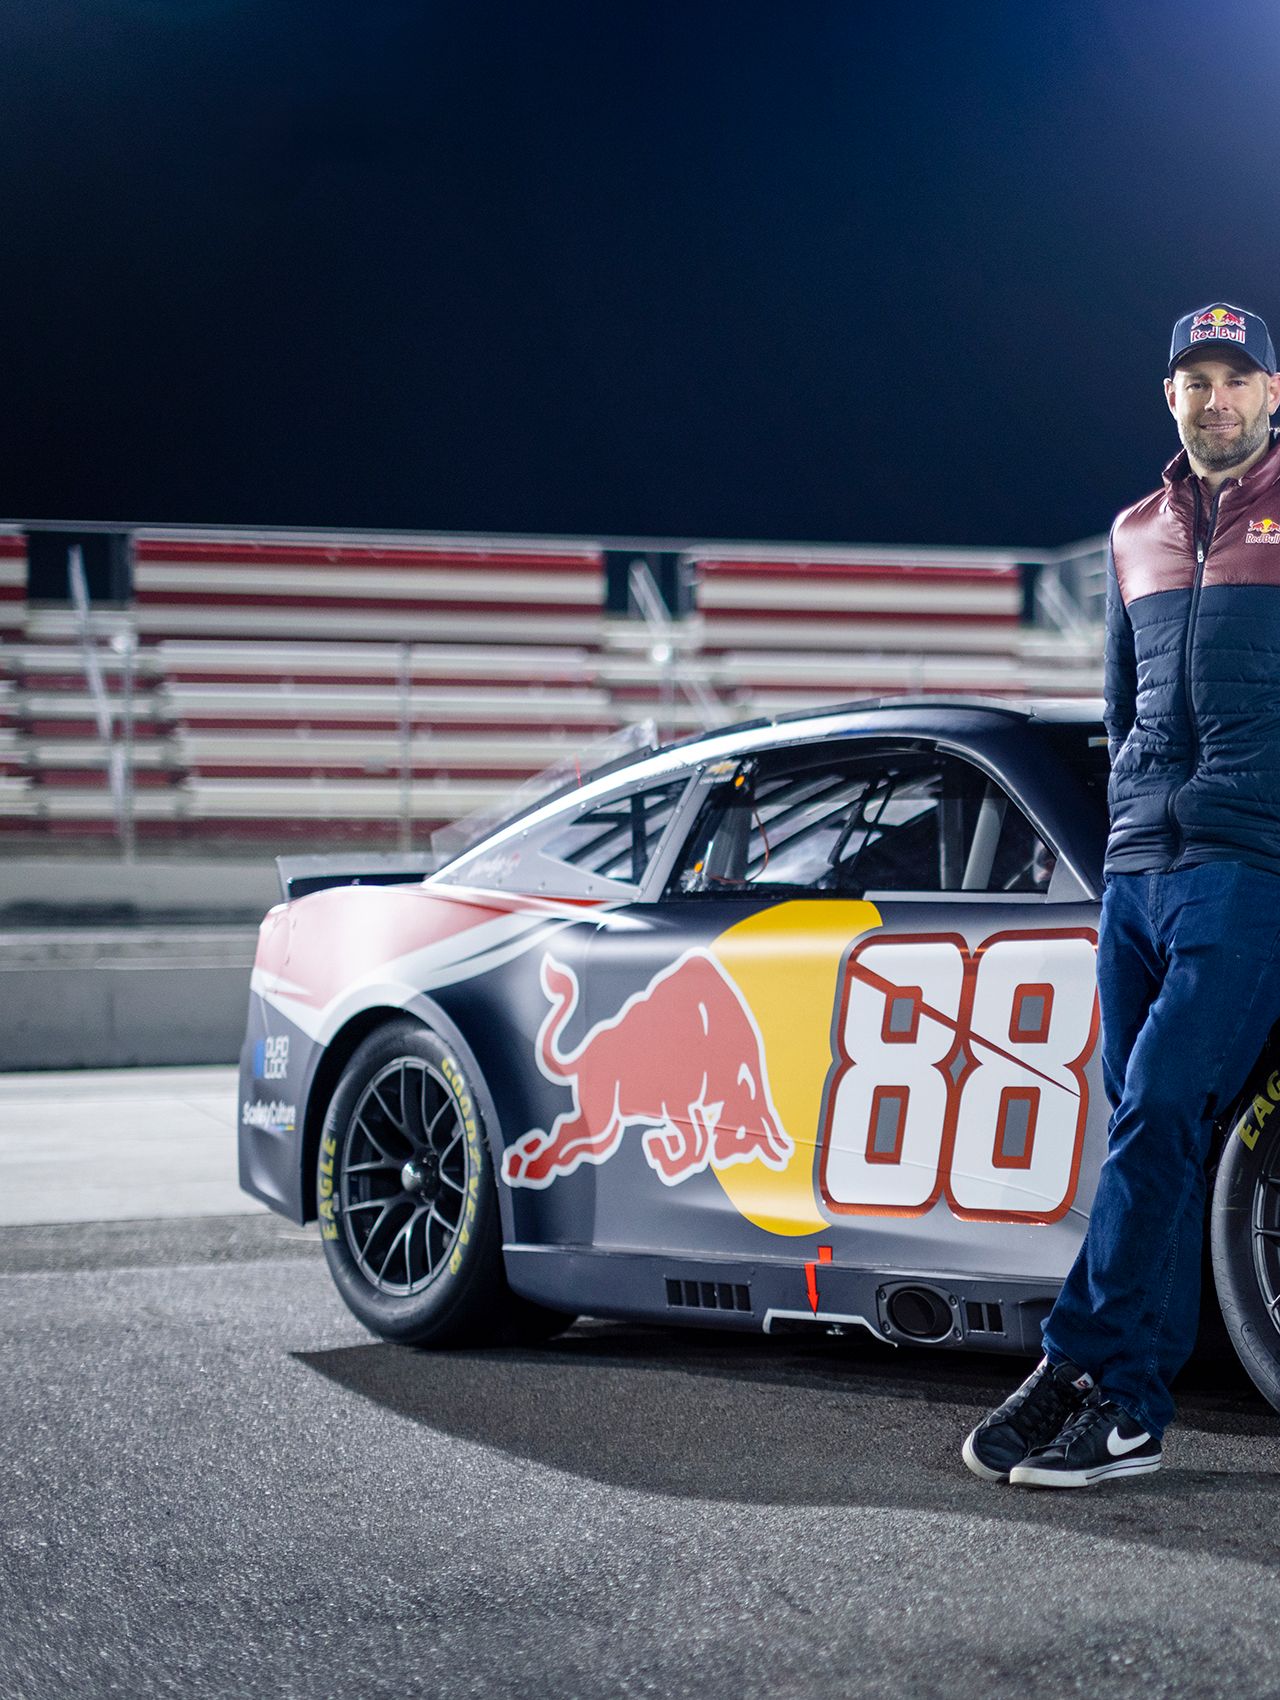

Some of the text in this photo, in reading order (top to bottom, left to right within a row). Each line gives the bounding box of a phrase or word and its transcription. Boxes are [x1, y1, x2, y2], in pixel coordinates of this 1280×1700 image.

[1191, 326, 1246, 344] Red Bull
[1246, 533, 1263, 544] Red
[818, 927, 1099, 1226] 88
[319, 1137, 339, 1241] EAGLE
